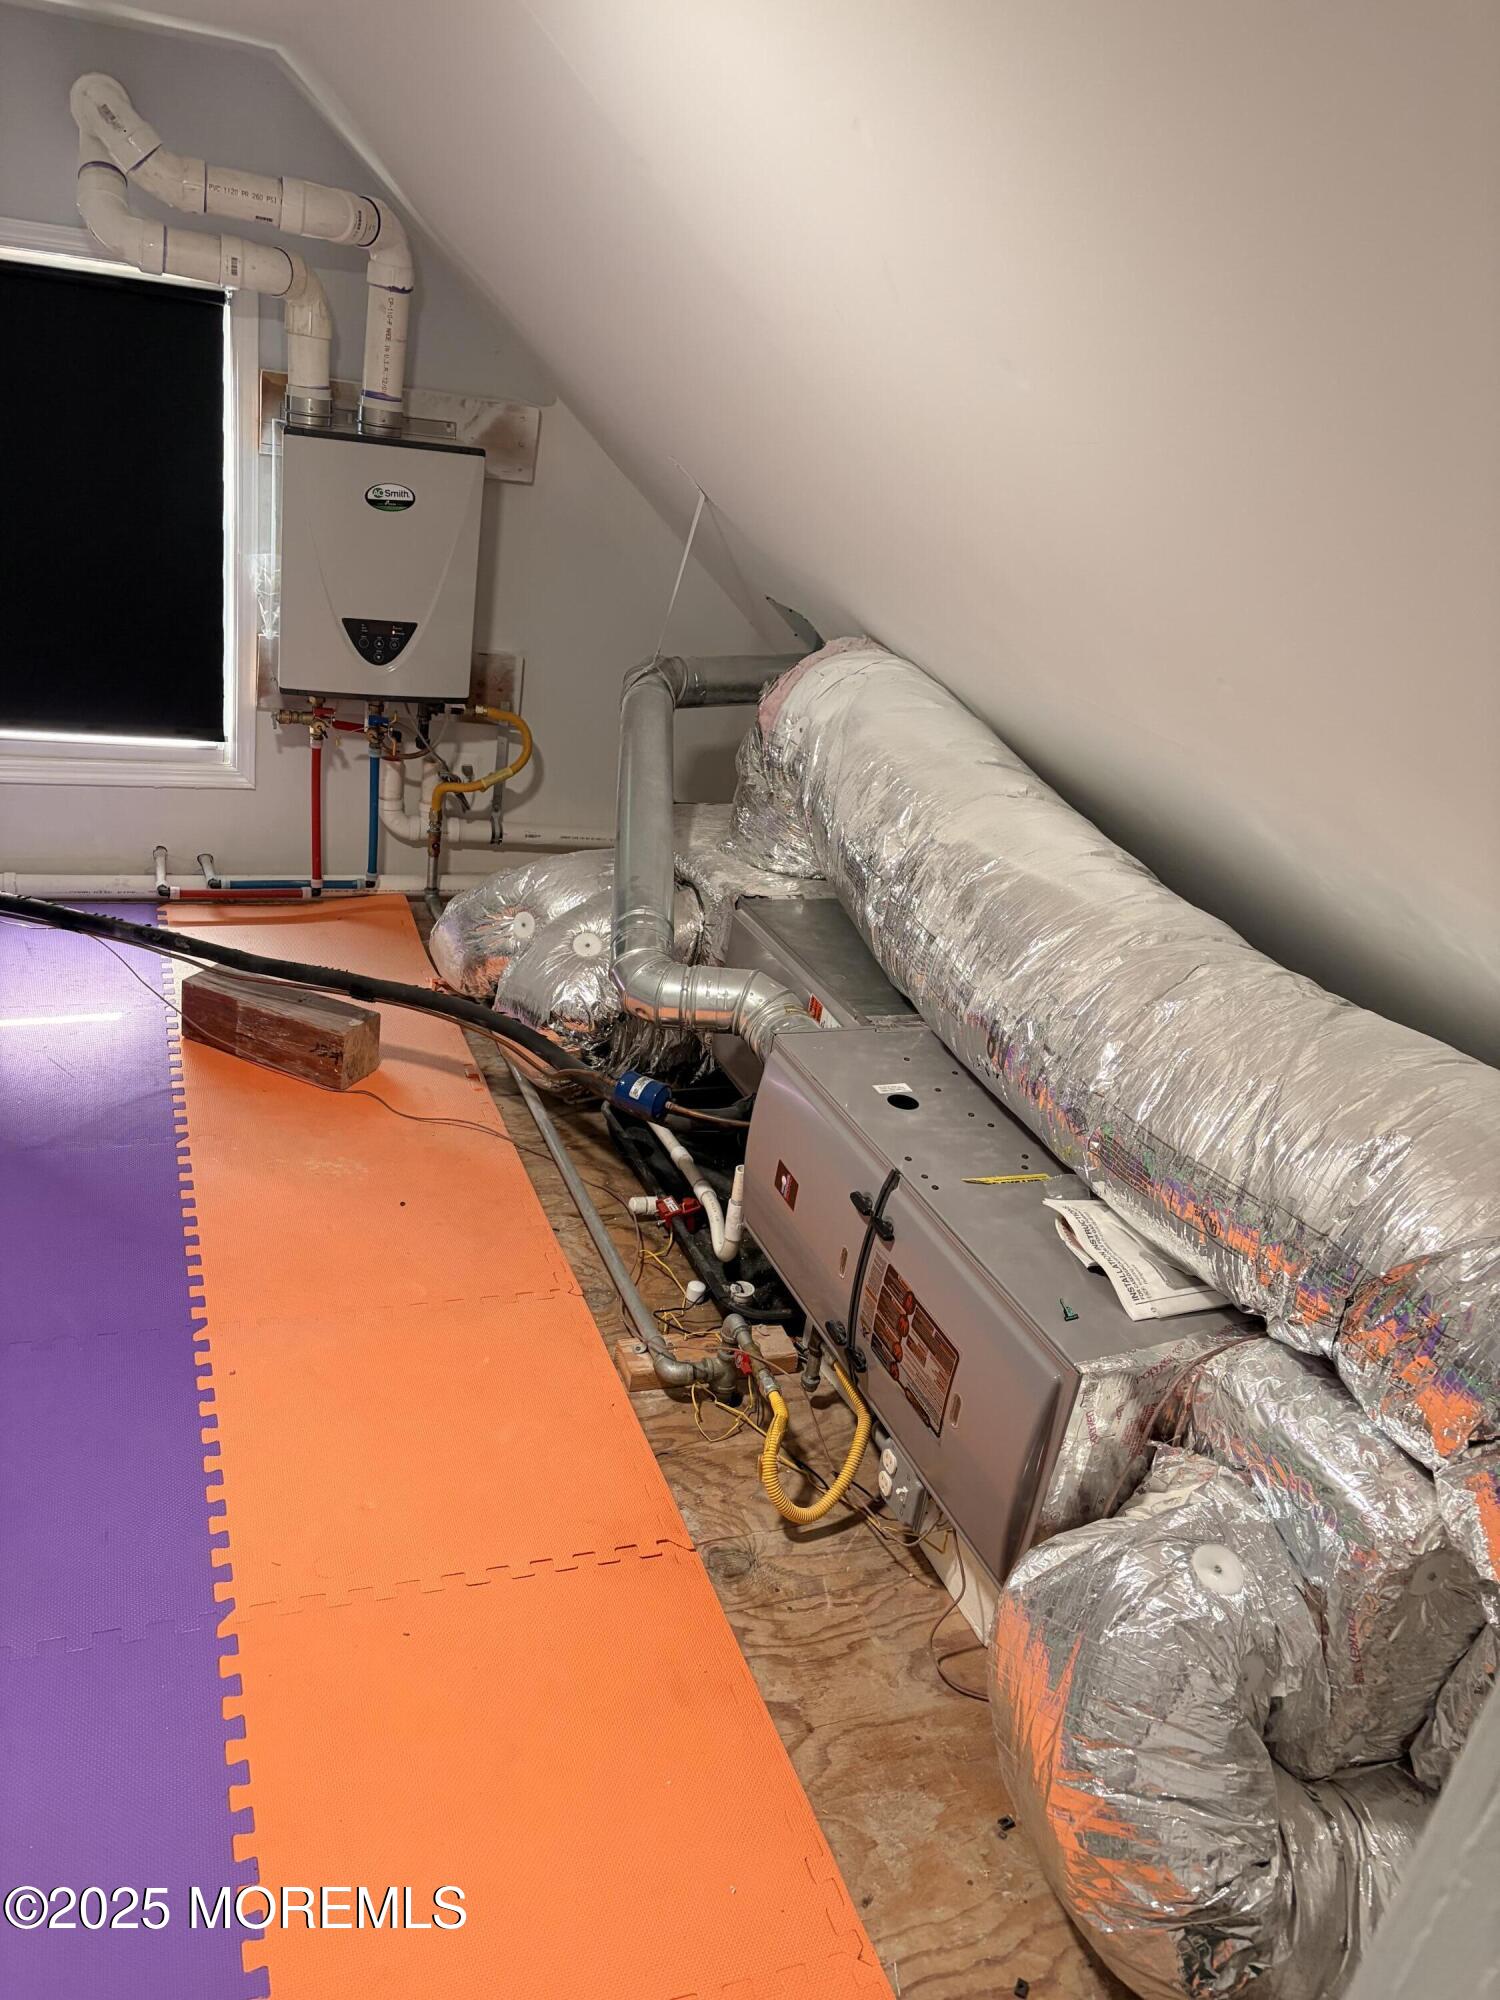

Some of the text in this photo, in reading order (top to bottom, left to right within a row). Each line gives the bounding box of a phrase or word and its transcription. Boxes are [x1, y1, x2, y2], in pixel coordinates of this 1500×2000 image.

[208, 183, 221, 192] PVC
[384, 489, 409, 498] Smith
[1099, 1250, 1140, 1303] INSTALLATION
